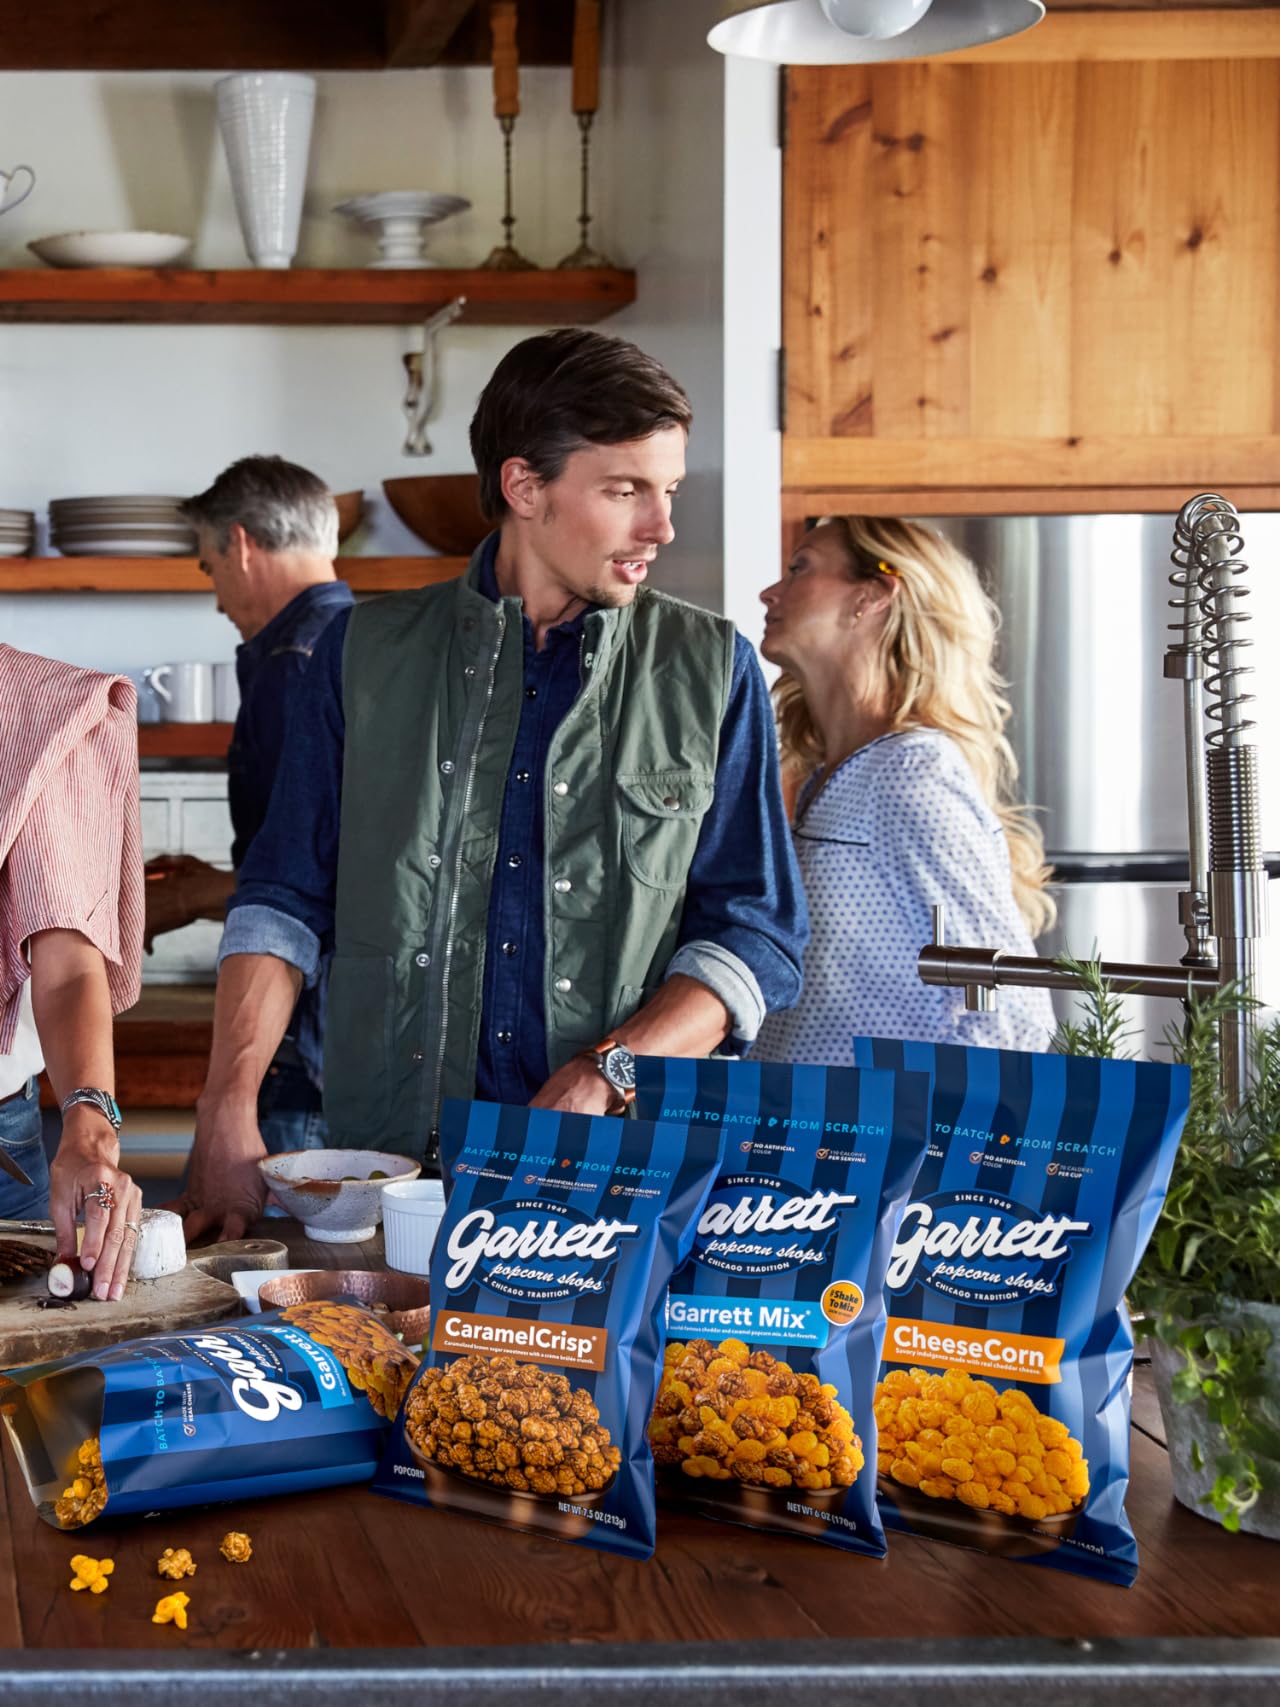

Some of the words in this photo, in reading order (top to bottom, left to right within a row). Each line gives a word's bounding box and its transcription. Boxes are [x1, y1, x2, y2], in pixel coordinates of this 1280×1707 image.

[663, 1108, 700, 1119] BATCH
[704, 1111, 719, 1121] TO
[723, 1115, 761, 1125] BATCH
[783, 1119, 819, 1130] FROM
[825, 1122, 884, 1135] SCRATCH
[764, 1144, 795, 1152] ARTIFICIAL
[935, 1123, 951, 1134] TO
[953, 1126, 994, 1142] BATCH
[1015, 1138, 1052, 1150] FROM
[1056, 1141, 1116, 1157] SCRATCH
[464, 1146, 500, 1159] BATCH
[503, 1152, 517, 1161] TO
[520, 1154, 556, 1166] BATCH
[575, 1161, 611, 1172] FROM
[614, 1166, 671, 1179] SCRATCH
[995, 1156, 1026, 1167] ARTIFICIAL
[728, 1177, 755, 1185] SINCE
[759, 1178, 781, 1188] 1949
[516, 1201, 542, 1209] SINCE
[547, 1203, 568, 1214] 1949
[697, 1190, 857, 1236] arrett
[954, 1194, 984, 1202] SINCE
[989, 1197, 1012, 1210] 1949
[445, 1209, 638, 1289] Garrett
[704, 1240, 773, 1258] popcorn
[776, 1244, 825, 1263] shops
[885, 1202, 1090, 1289] Garrett
[490, 1263, 554, 1282] popcorn
[557, 1272, 603, 1292] shops
[707, 1257, 742, 1272] CHICAGO
[746, 1262, 790, 1273] TRADITION
[932, 1261, 1001, 1281] popcorn
[1004, 1272, 1055, 1294] shops
[491, 1281, 524, 1297] CHICAGO
[527, 1289, 569, 1299] TRADITION
[935, 1281, 970, 1298] CHICAGO
[974, 1291, 1018, 1301] TRADITION
[670, 1301, 752, 1326] Garrett
[893, 1325, 1044, 1368] CheeseCorn
[284, 1334, 336, 1390] Garrett
[154, 1390, 166, 1407] TO
[154, 1410, 168, 1450] BATCH
[393, 1464, 425, 1479] POPCORN
[558, 1501, 571, 1513] NET
[571, 1505, 582, 1515] WT
[583, 1508, 594, 1519] 7.5
[594, 1511, 604, 1521] OZ
[604, 1513, 627, 1529] (213g)
[787, 1501, 800, 1513] NET
[801, 1505, 813, 1516] WT
[814, 1509, 820, 1518] 6
[821, 1511, 831, 1521] OZ
[831, 1514, 857, 1531] (170g)
